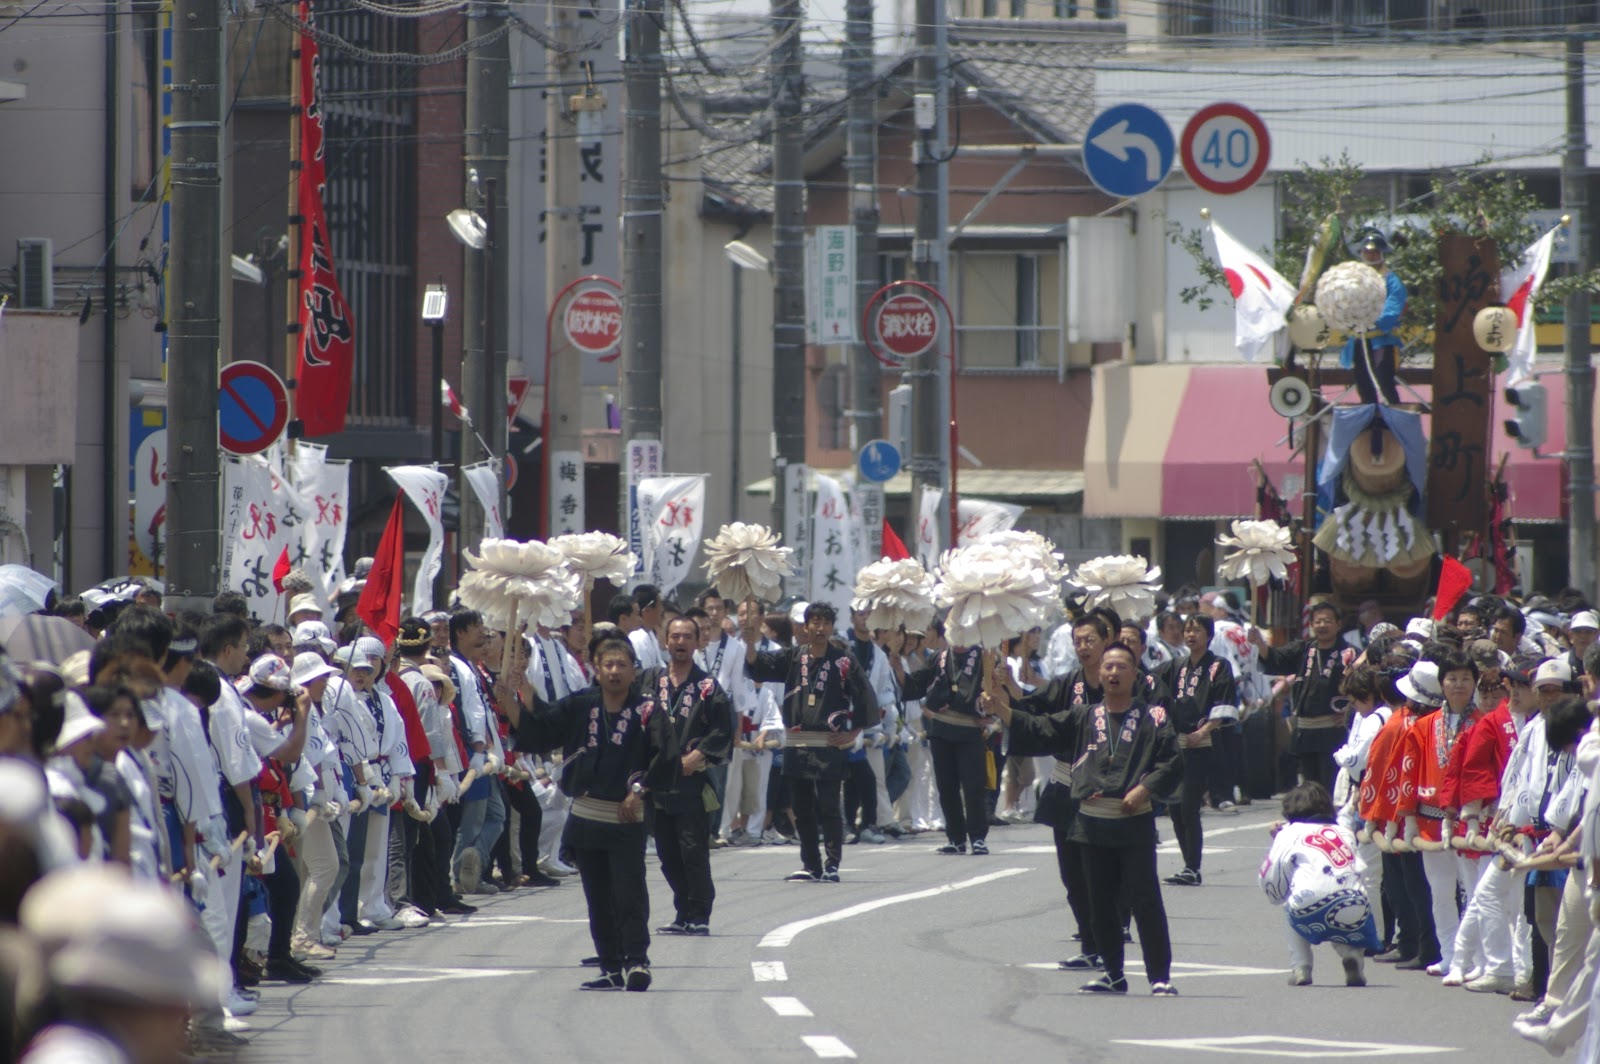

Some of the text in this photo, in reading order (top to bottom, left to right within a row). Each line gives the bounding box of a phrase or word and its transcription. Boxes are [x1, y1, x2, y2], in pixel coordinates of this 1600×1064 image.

[1202, 129, 1249, 169] 40
[883, 312, 933, 337] 消火栓
